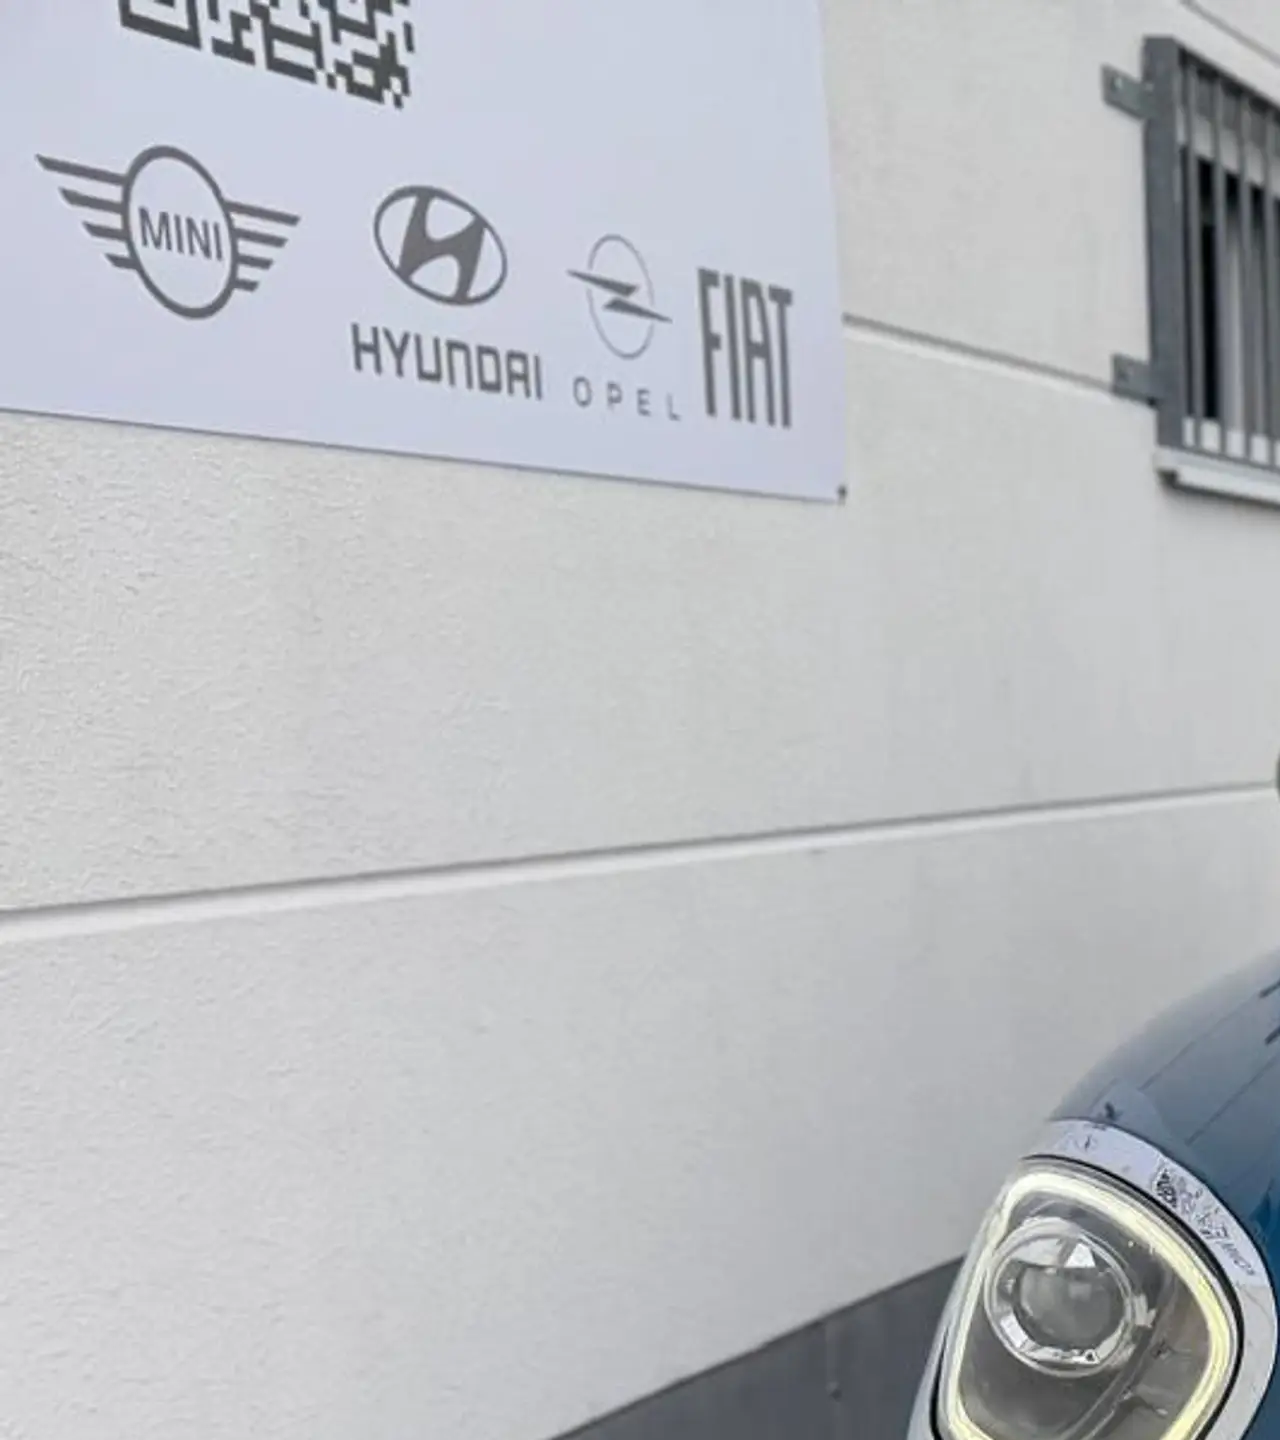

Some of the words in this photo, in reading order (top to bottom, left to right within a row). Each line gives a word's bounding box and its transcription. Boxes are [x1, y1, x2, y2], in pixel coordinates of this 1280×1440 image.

[138, 206, 223, 262] MINI
[351, 322, 543, 401] HYUNDAI
[696, 266, 795, 429] FIAT
[572, 377, 682, 422] OPEL
